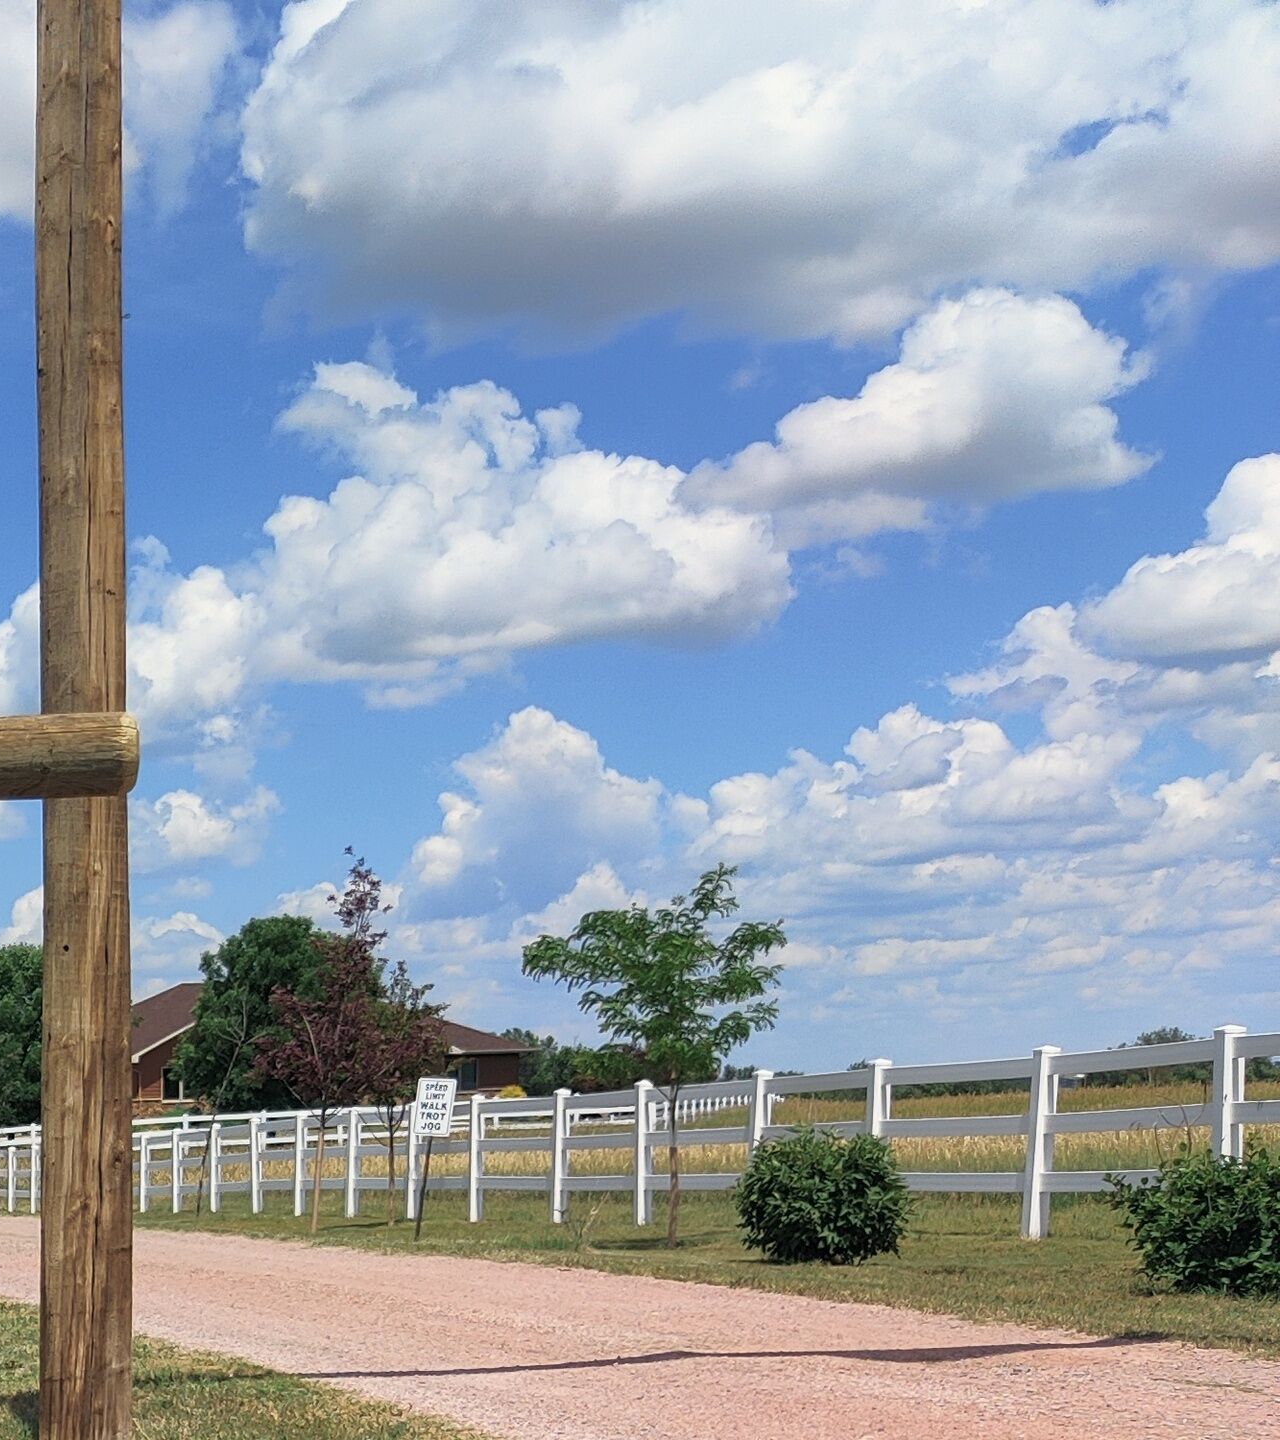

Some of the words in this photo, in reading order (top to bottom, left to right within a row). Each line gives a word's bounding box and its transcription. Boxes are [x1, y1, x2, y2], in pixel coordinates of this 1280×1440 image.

[425, 1082, 448, 1091] SPEED
[420, 1101, 447, 1110] WALK
[419, 1112, 446, 1120] TROT
[421, 1122, 441, 1130] JOG
